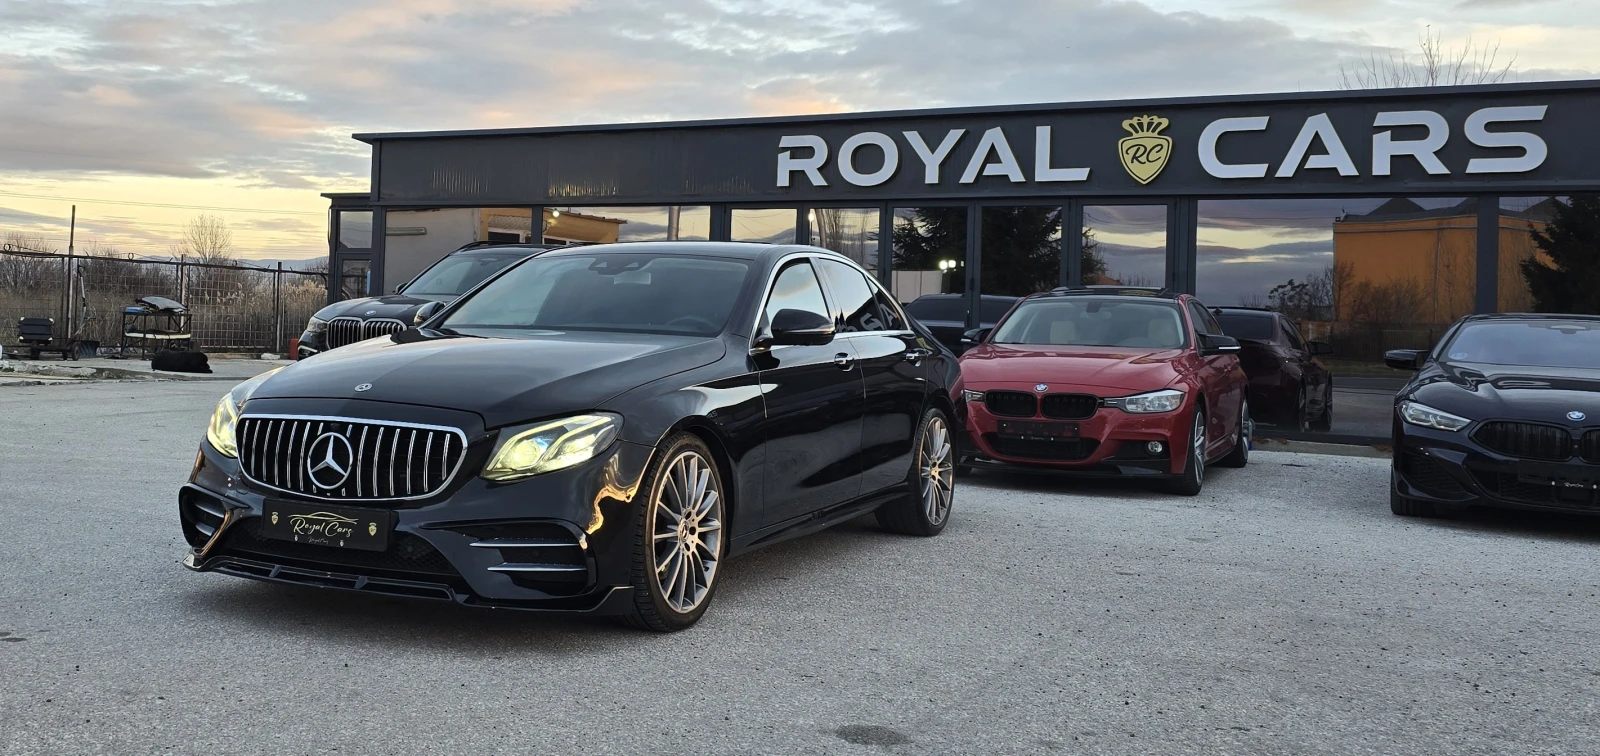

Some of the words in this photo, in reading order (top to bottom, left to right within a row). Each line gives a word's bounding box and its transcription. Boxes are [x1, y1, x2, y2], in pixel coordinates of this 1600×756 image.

[777, 126, 1090, 187] ROYAL
[1125, 143, 1164, 165] RC
[1198, 105, 1549, 178] CARS
[290, 517, 326, 535] Royal
[325, 521, 353, 537] Cars
